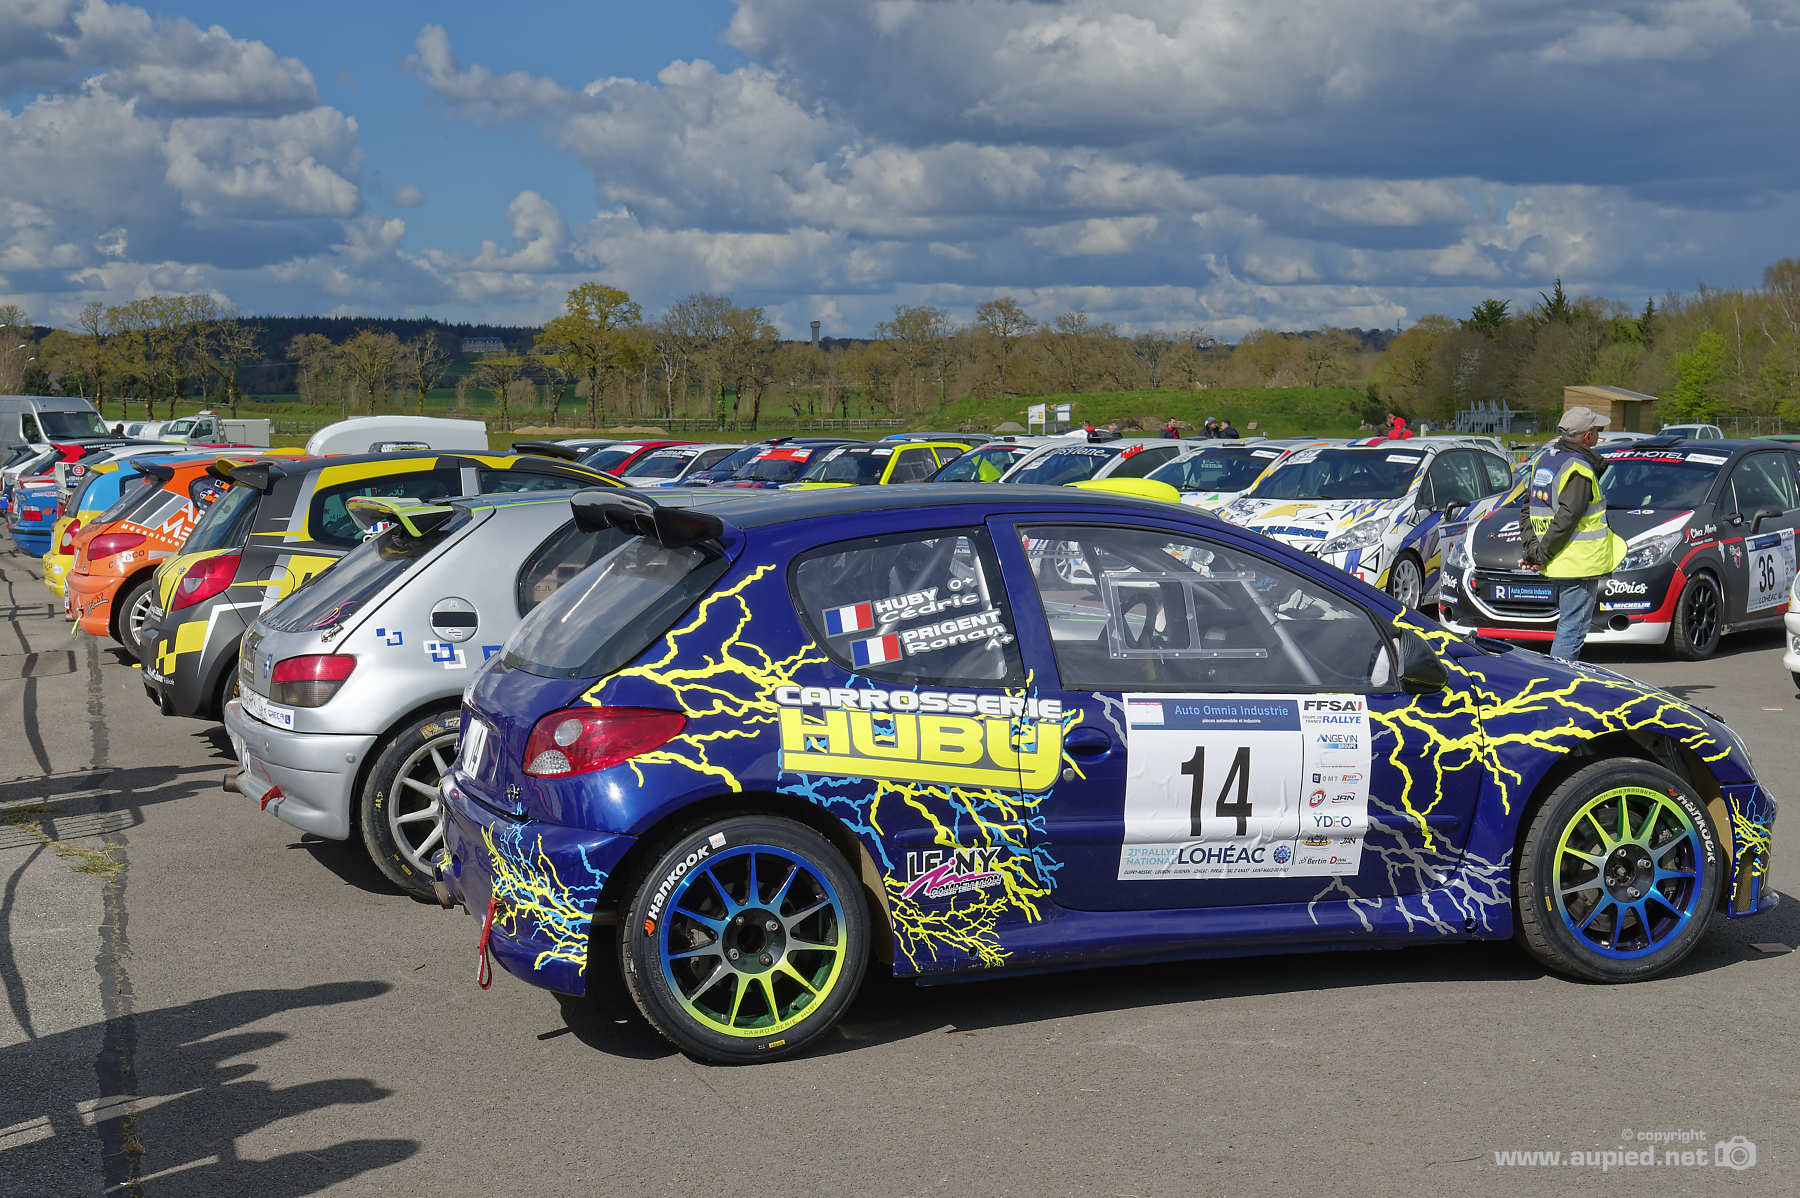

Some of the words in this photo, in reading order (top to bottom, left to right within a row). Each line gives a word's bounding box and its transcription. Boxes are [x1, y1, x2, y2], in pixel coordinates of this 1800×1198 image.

[1636, 450, 1685, 460] HOTEL
[1758, 554, 1776, 592] 36
[1605, 579, 1648, 596] Stories
[875, 588, 938, 613] HUBY
[879, 593, 978, 623] Cédric
[901, 609, 1001, 644] PRIGENT
[905, 624, 1006, 655] Ronan
[776, 686, 1063, 719] CARROSSERIE
[1175, 705, 1200, 716] Auto
[1203, 705, 1237, 716] Omnia
[1240, 705, 1289, 716] Industrie
[1323, 715, 1362, 724] RALLYE
[778, 706, 1064, 793] HUBY
[1316, 734, 1358, 743] ANGEVIN
[1181, 746, 1252, 836] 14
[1142, 848, 1178, 856] RALLYE
[1177, 844, 1266, 865] LOHÉAC
